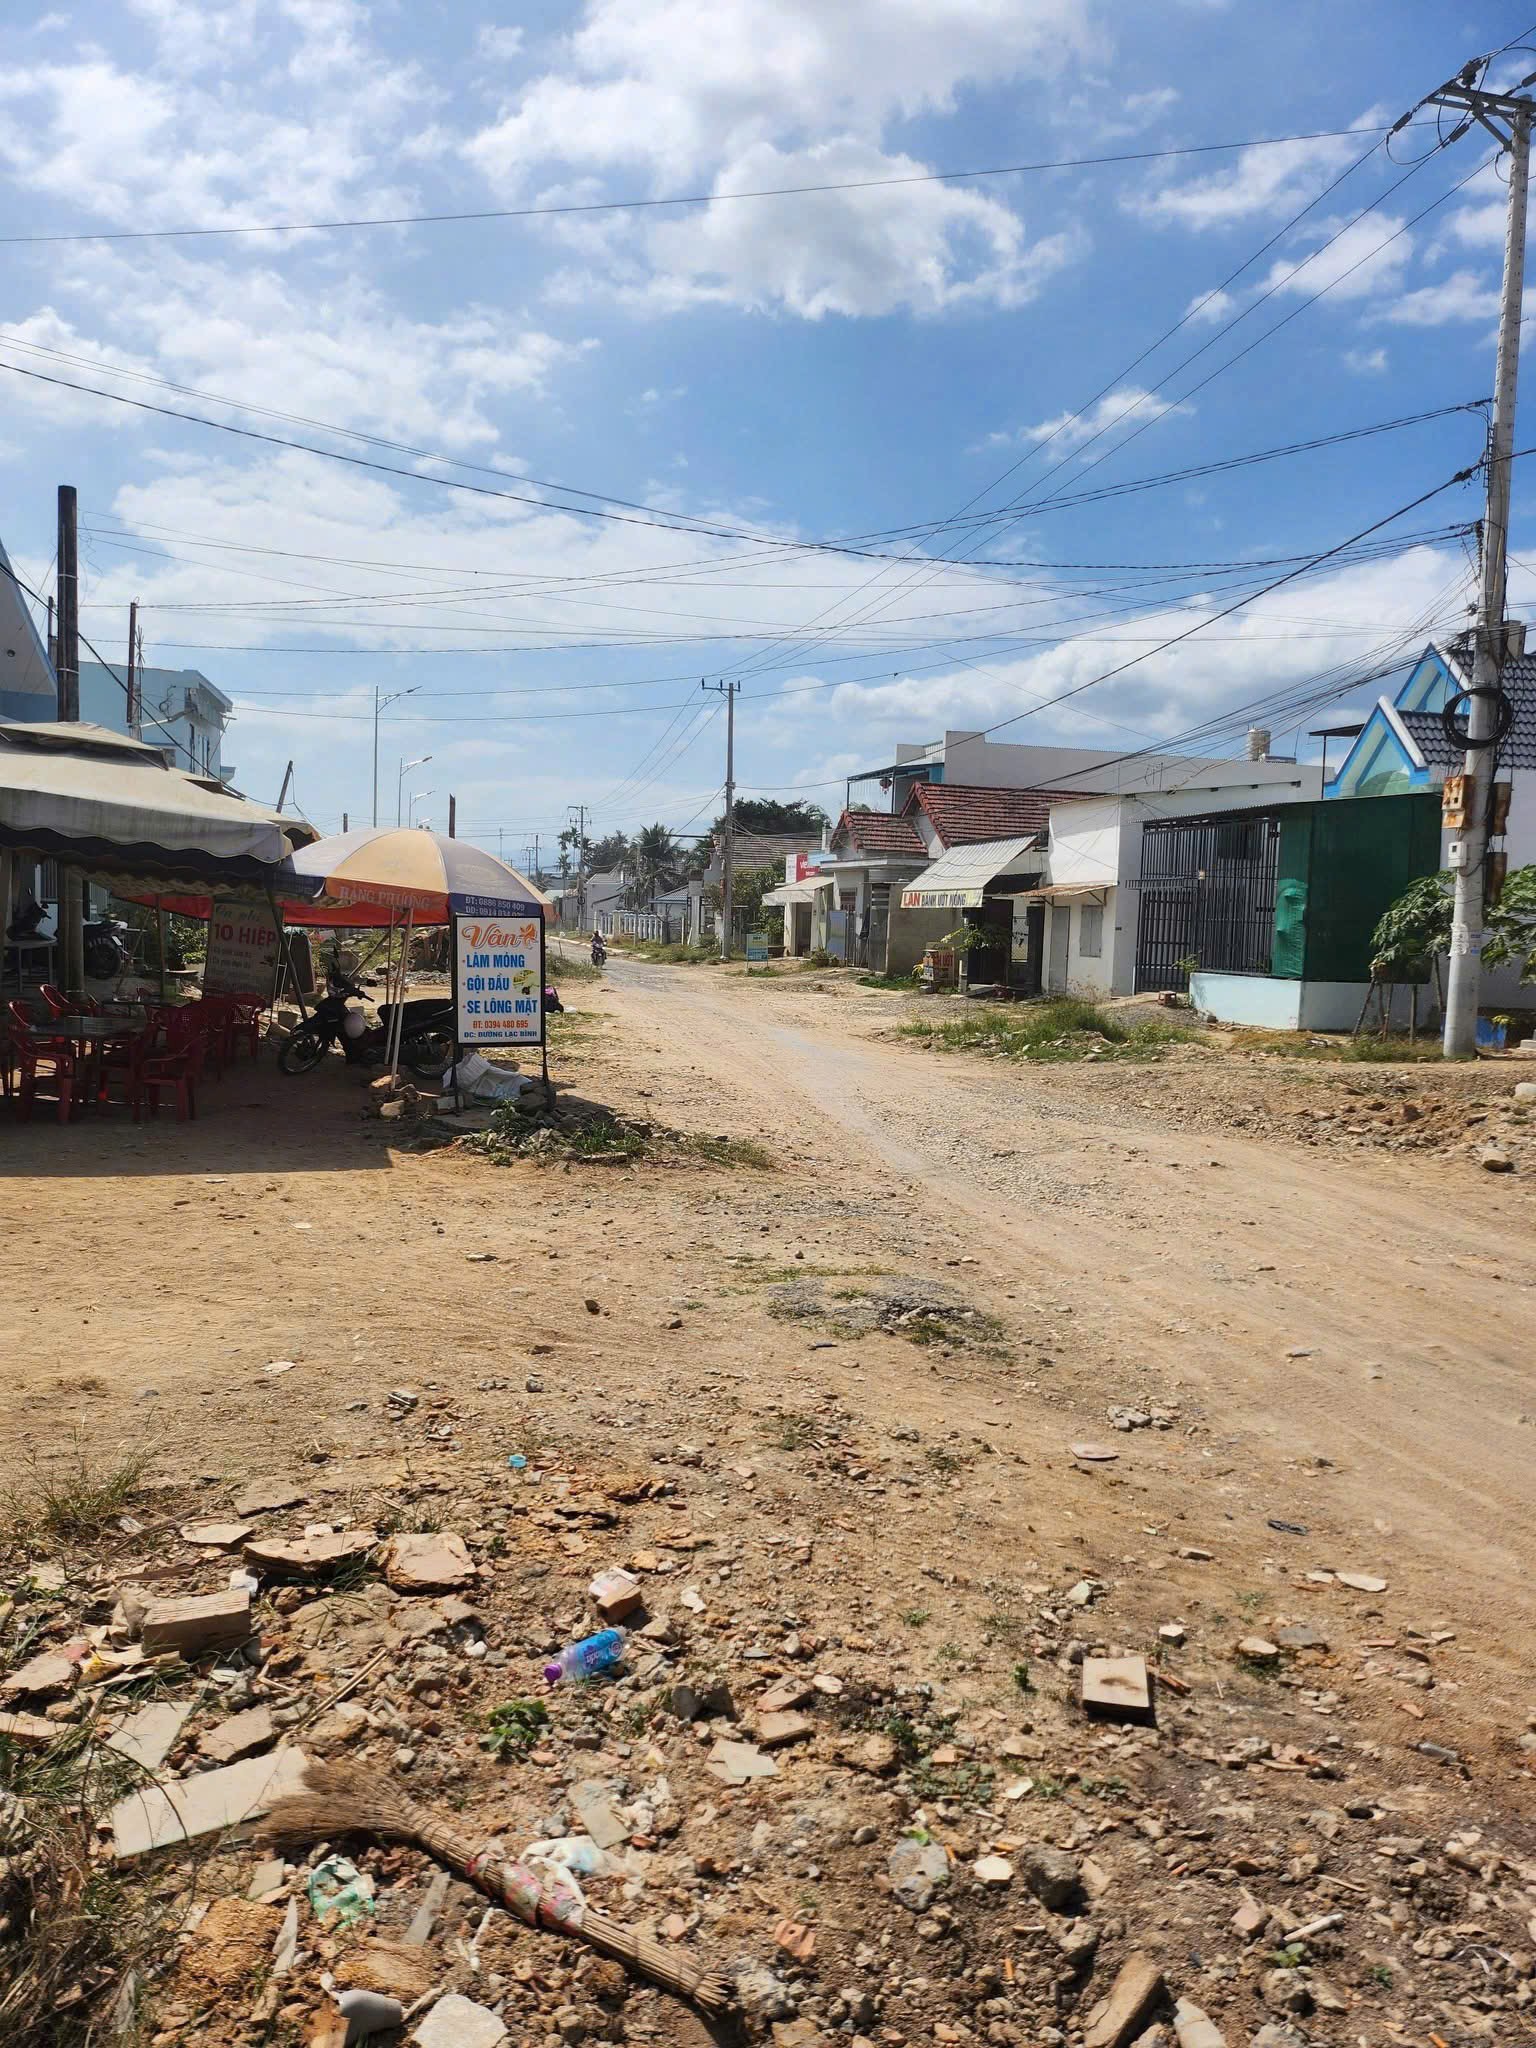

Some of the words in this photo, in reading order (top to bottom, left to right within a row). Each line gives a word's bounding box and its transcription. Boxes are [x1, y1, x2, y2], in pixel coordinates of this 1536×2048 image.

[903, 892, 921, 907] LAN
[239, 925, 277, 951] HIỆP
[461, 923, 519, 949] Vân
[466, 951, 490, 968] LÀM
[493, 951, 525, 968] MÓNG
[467, 974, 485, 994] GỘI
[488, 972, 510, 991] ĐẦU
[467, 1000, 481, 1014] SE
[484, 997, 512, 1014] LÔNG
[515, 997, 538, 1016] MẶT
[472, 1020, 483, 1029] ĐT:
[484, 1020, 501, 1029] 0394
[502, 1020, 515, 1029] 480
[516, 1020, 529, 1028] 695
